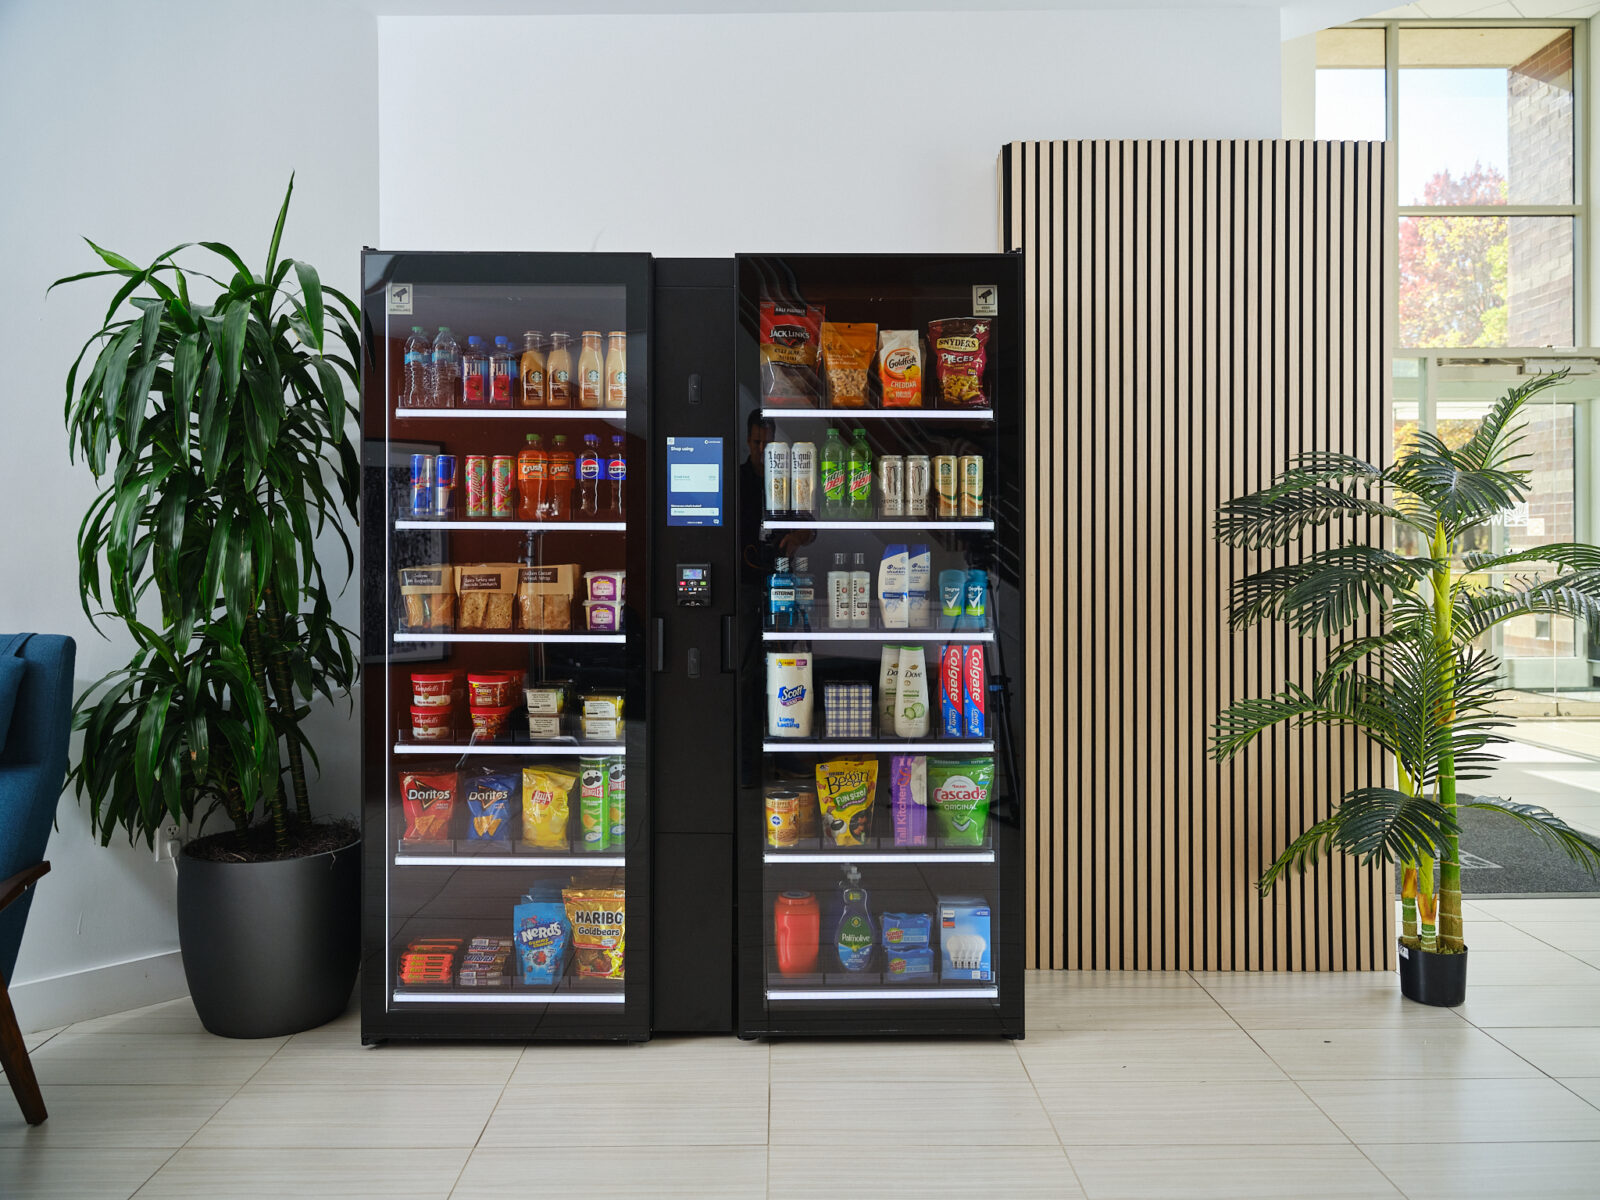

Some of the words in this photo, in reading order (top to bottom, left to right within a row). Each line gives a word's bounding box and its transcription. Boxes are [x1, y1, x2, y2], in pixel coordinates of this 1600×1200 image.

[769, 330, 788, 338] JACK
[888, 356, 917, 369] Goldfish
[941, 354, 974, 364] PIECES
[465, 363, 480, 376] FIJI
[491, 363, 507, 376] FIJI
[792, 451, 811, 460] Lquid
[522, 464, 543, 474] Crush
[550, 465, 570, 475] Crush
[904, 670, 922, 678] Dove
[949, 648, 960, 701] Colgate
[970, 648, 981, 702] Colgate
[781, 685, 804, 701] Scott
[408, 789, 450, 800] Doritos
[468, 790, 508, 801] Doritos
[933, 786, 987, 803] Cascade
[896, 785, 907, 825] Kitchen
[896, 828, 906, 844] Tall
[578, 926, 620, 936] Goldbears
[841, 933, 871, 942] Palmolive
